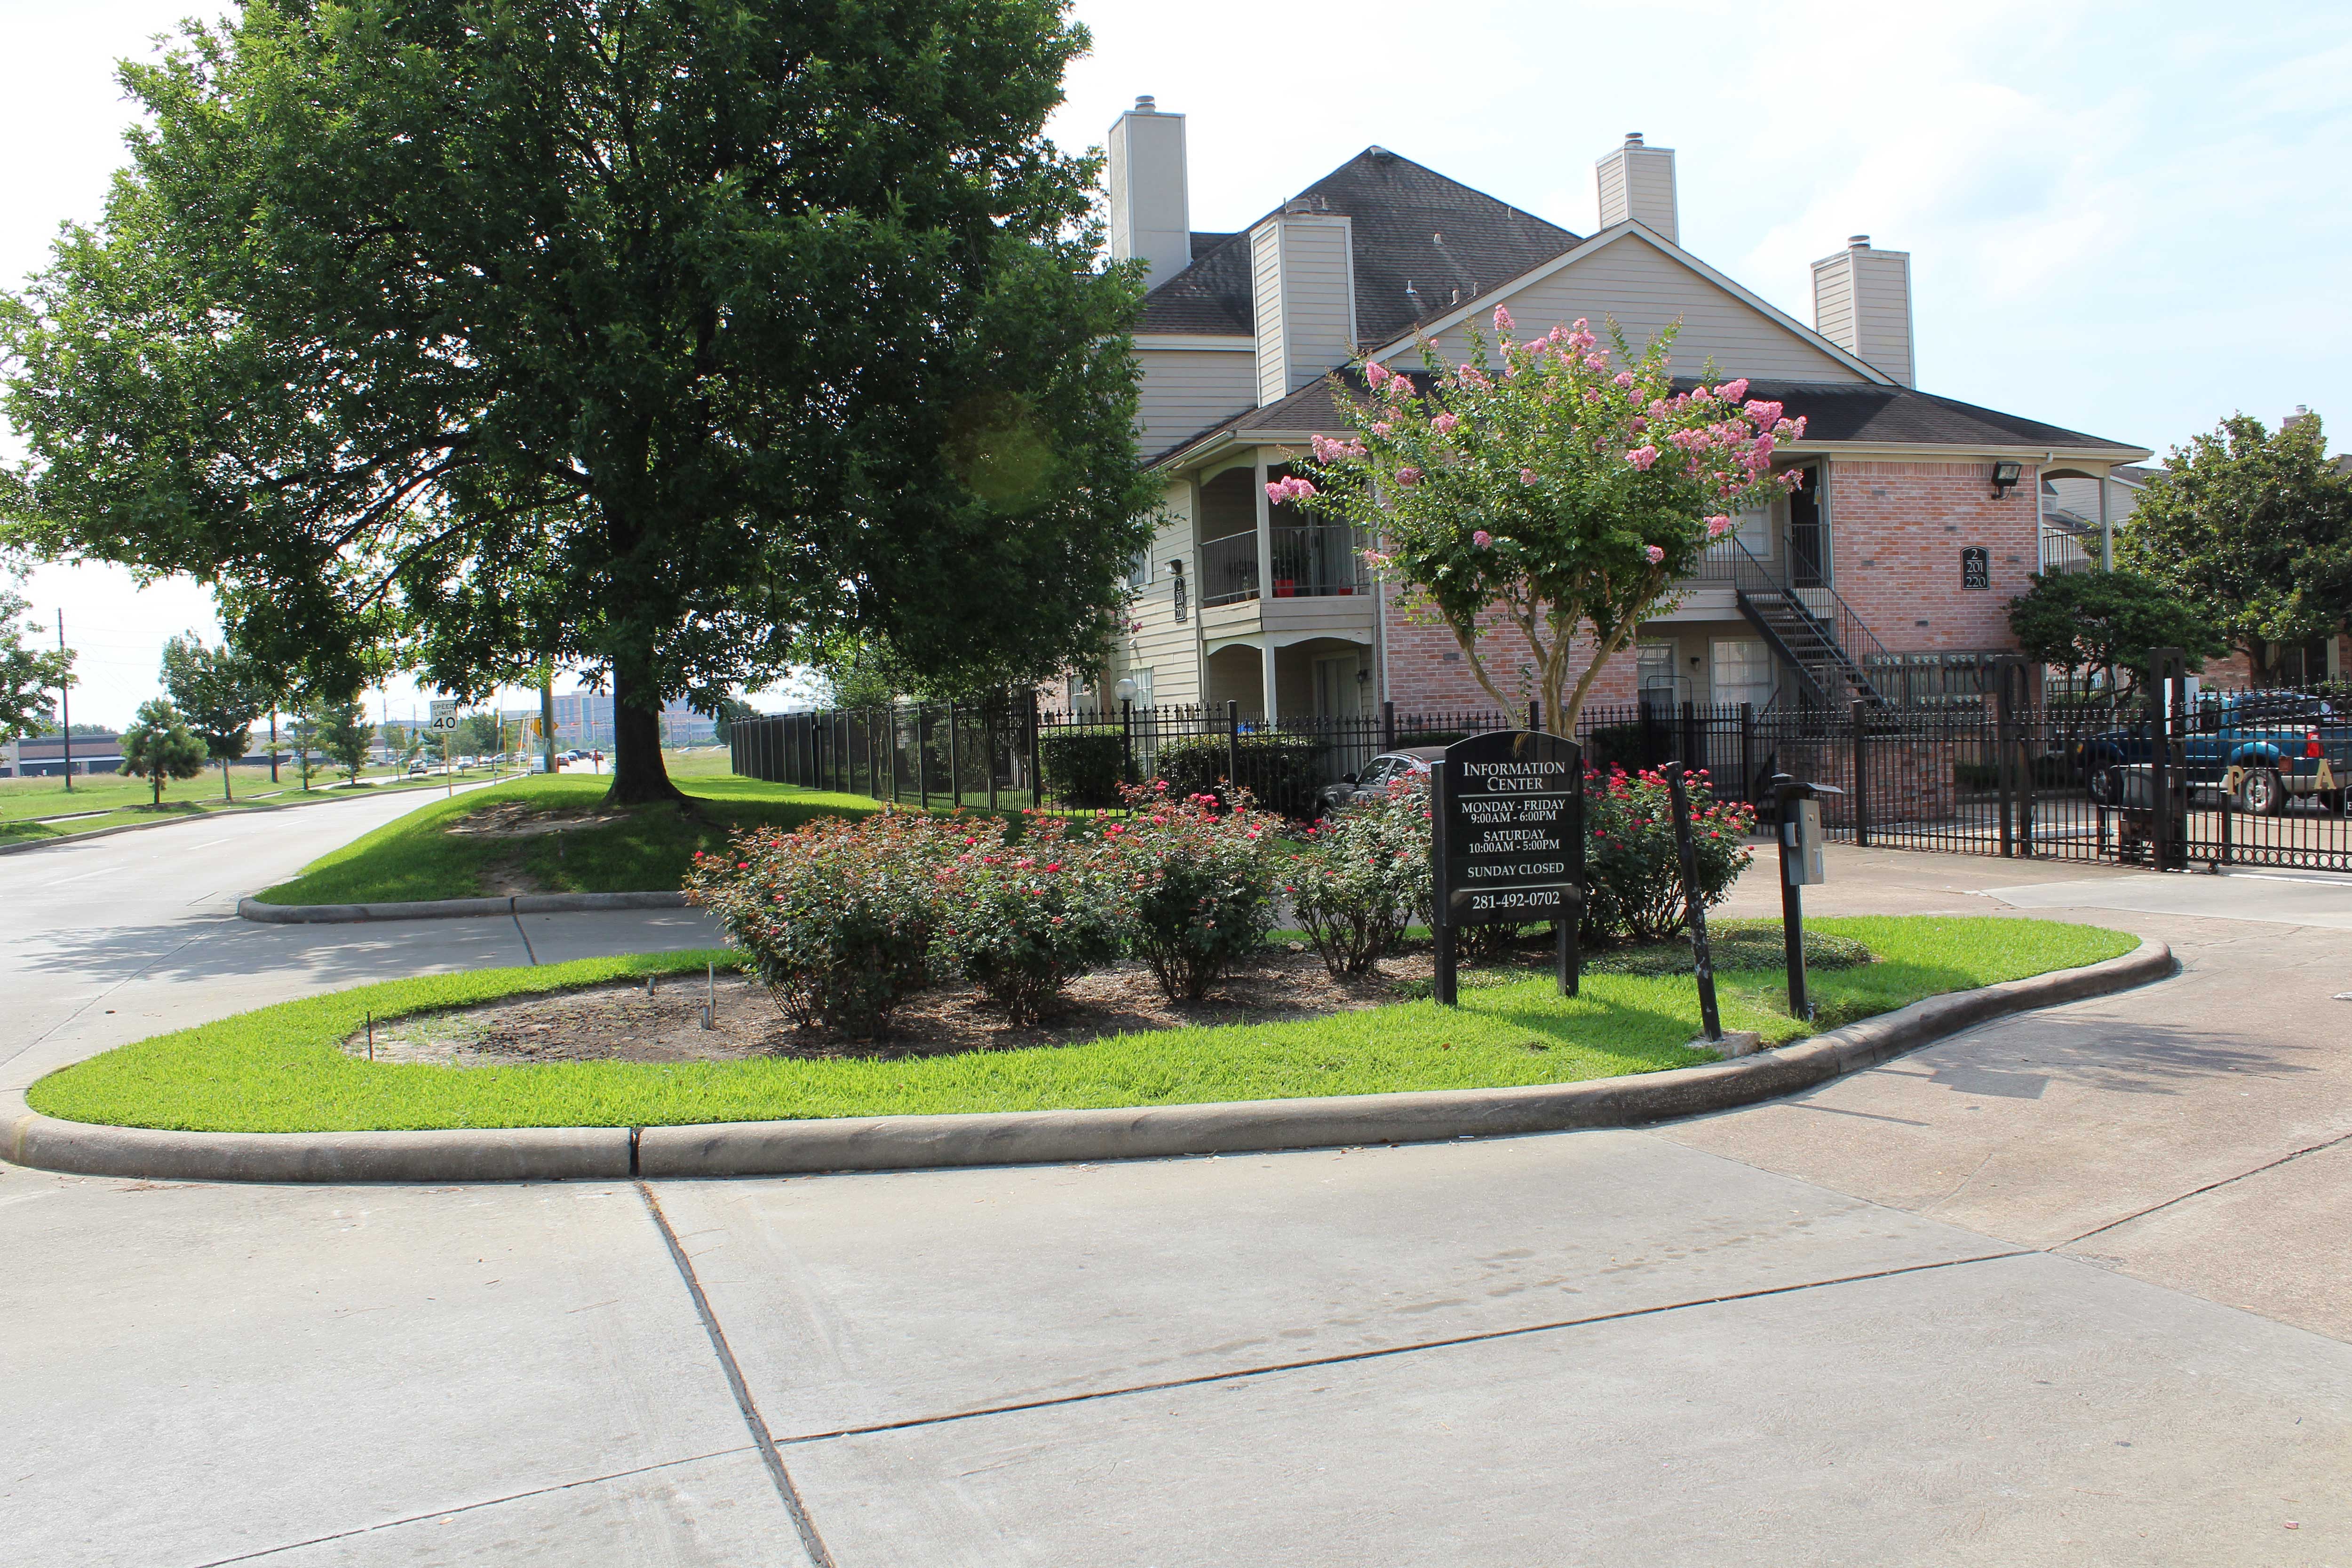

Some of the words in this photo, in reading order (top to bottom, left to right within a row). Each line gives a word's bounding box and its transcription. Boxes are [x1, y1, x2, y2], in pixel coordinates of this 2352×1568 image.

[1971, 549, 1978, 559] 2
[1967, 562, 1983, 572] 201
[1177, 579, 1181, 590] 2
[1966, 577, 1985, 587] 220
[1176, 607, 1184, 619] 220
[434, 717, 455, 729] 40
[1463, 762, 1565, 776] INFORMATION
[1487, 777, 1543, 791] CENTER
[1462, 801, 1515, 813] MONDAY
[1524, 799, 1565, 811] FRIDAY
[1471, 812, 1511, 823] 9:00AM
[1519, 810, 1557, 821] 6:00PM
[1484, 829, 1545, 842] SATURDAY
[1469, 841, 1514, 853] 10:00AM
[1523, 839, 1560, 851] 5:00PM
[1468, 865, 1517, 877] SUNDAY
[1519, 862, 1564, 875] CLOSED
[1472, 891, 1560, 909] 281-492-0702
